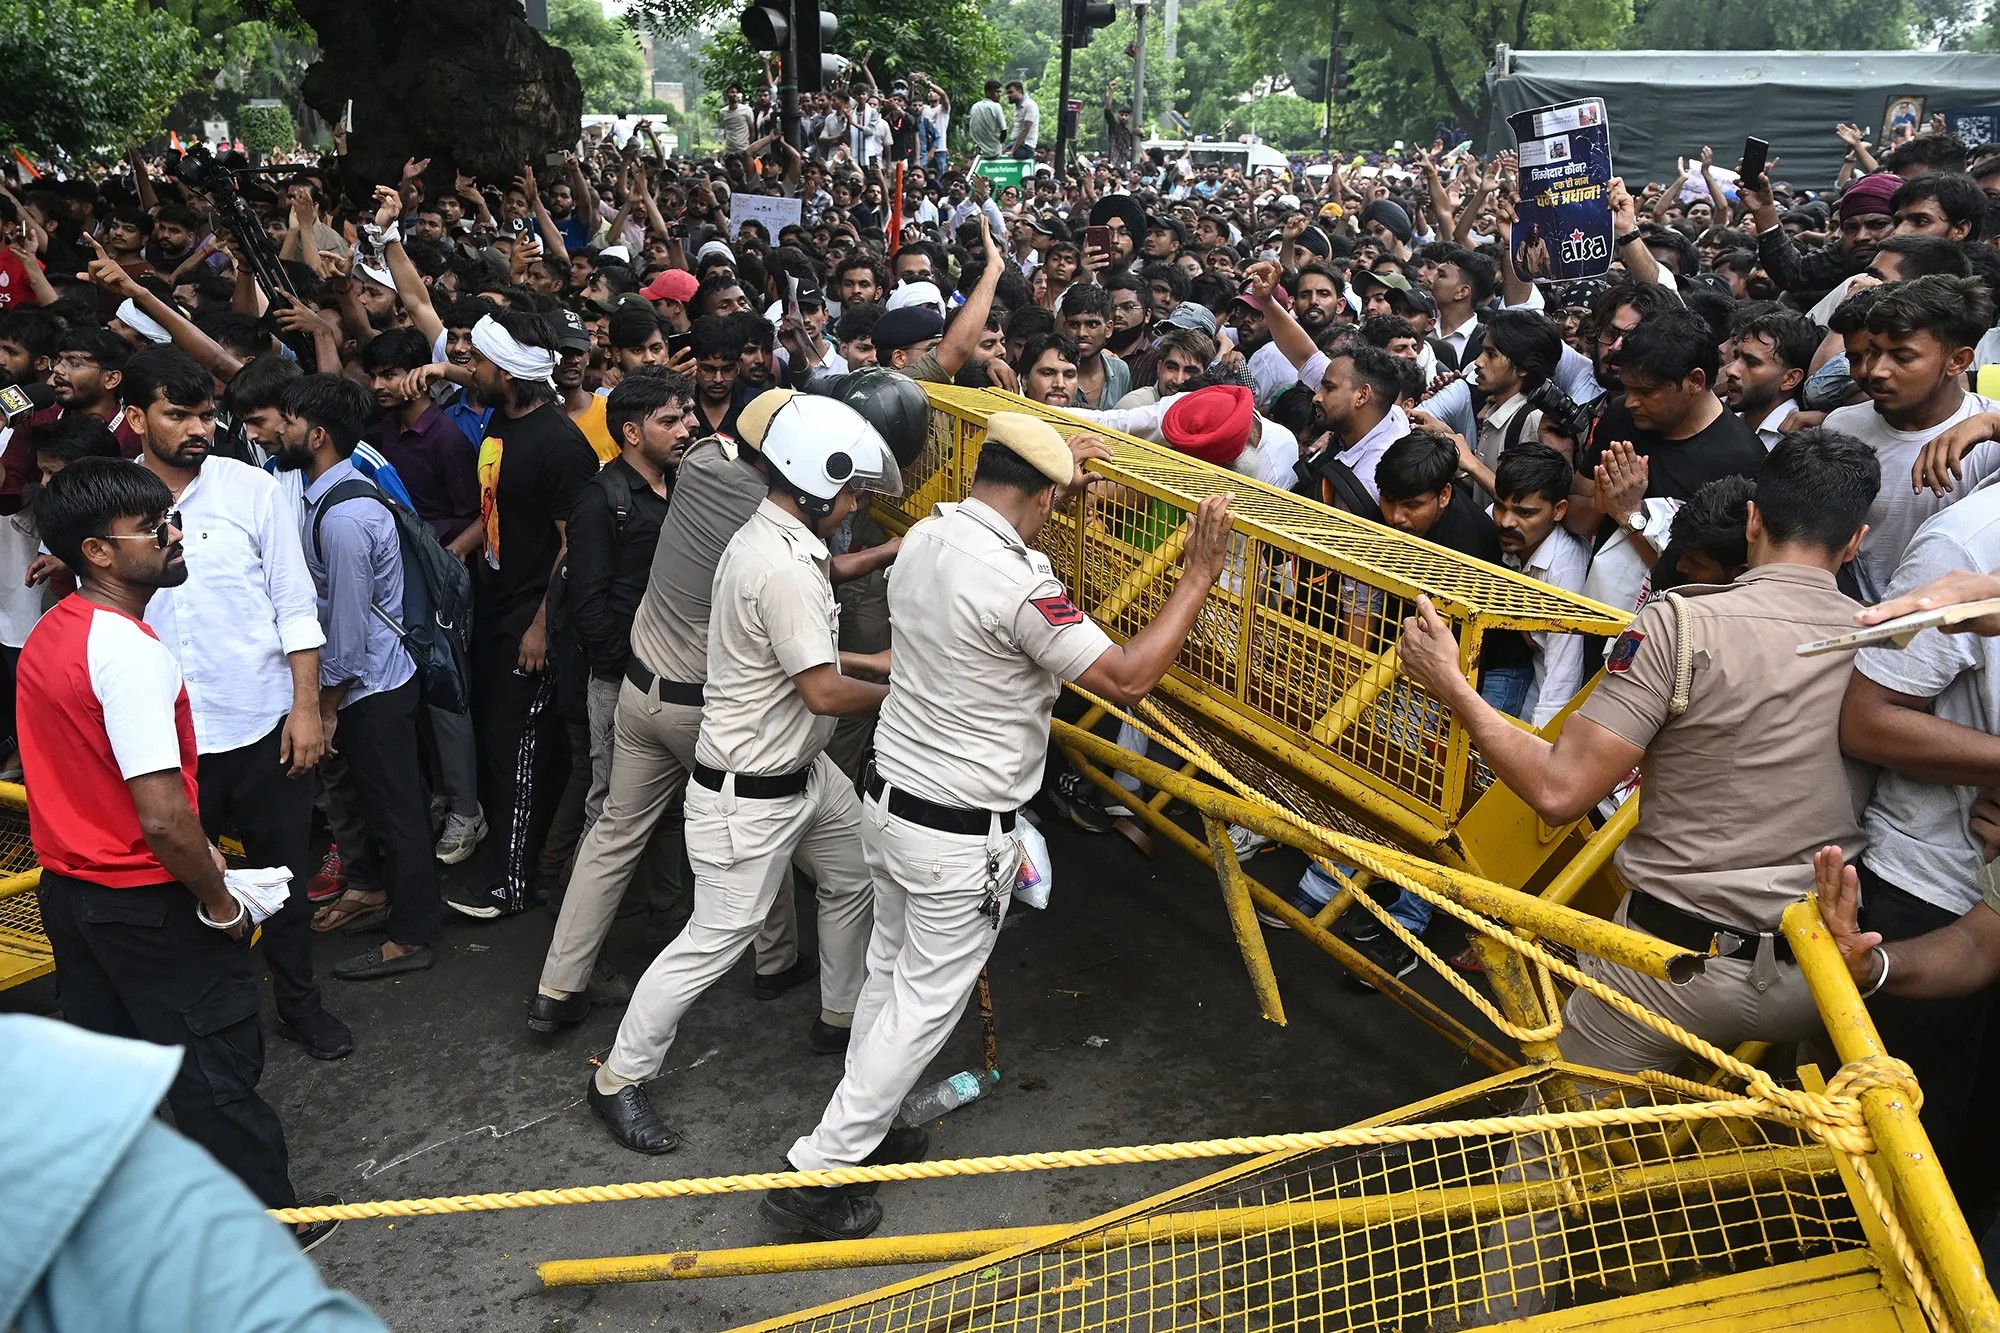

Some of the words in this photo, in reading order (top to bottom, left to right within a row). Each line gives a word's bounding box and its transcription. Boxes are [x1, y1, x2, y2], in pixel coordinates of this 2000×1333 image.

[1531, 167, 1563, 181] जिम्मेदार
[1564, 162, 1587, 176] कौन?
[1553, 181, 1565, 190] एक
[1566, 178, 1574, 188] ही
[1574, 177, 1589, 186] नाम
[1561, 184, 1601, 205] प्रधान!
[1562, 230, 1607, 263] aisa
